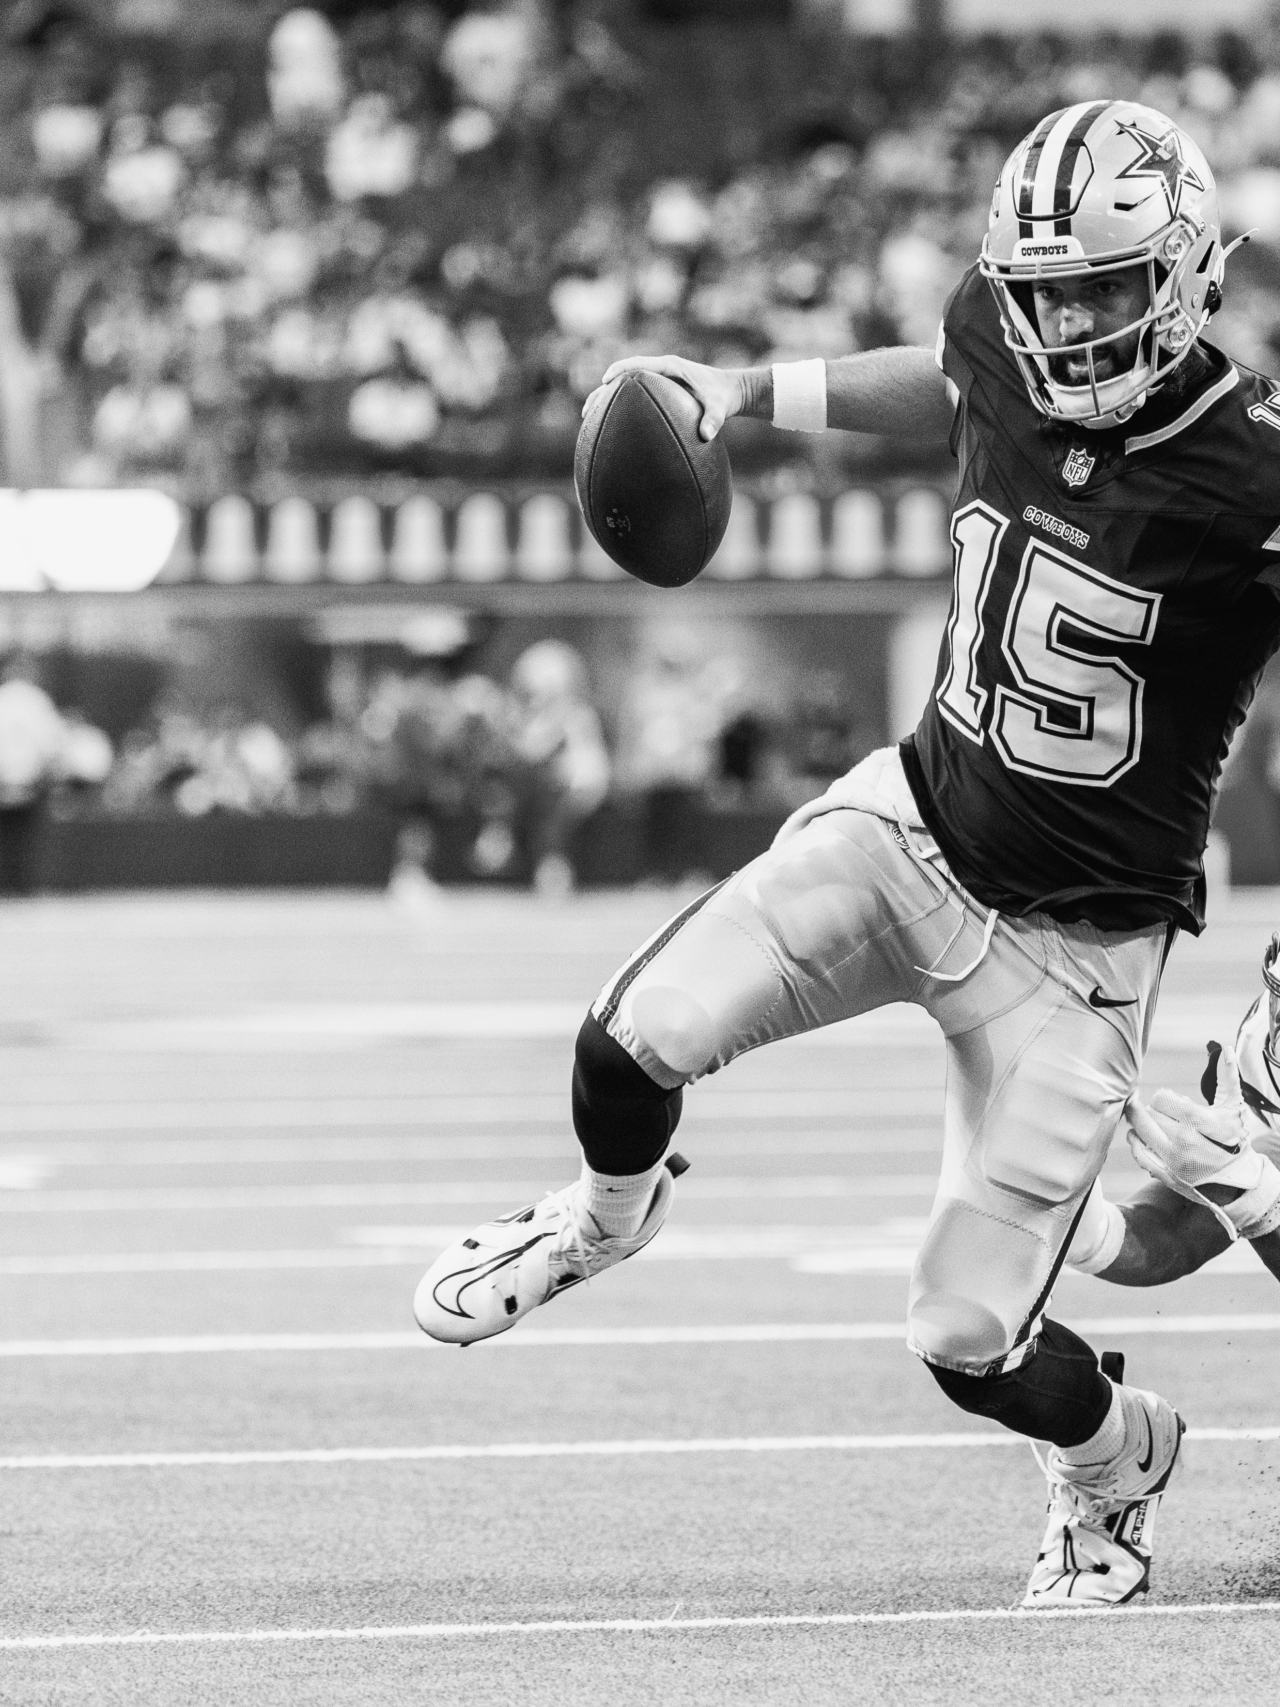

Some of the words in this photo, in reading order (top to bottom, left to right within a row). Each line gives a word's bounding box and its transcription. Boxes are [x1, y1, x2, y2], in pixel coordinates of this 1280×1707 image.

[1021, 244, 1068, 256] COWBOYS
[1066, 463, 1086, 481] NFL
[1022, 505, 1090, 549] COWBOYS
[936, 498, 1164, 788] 15
